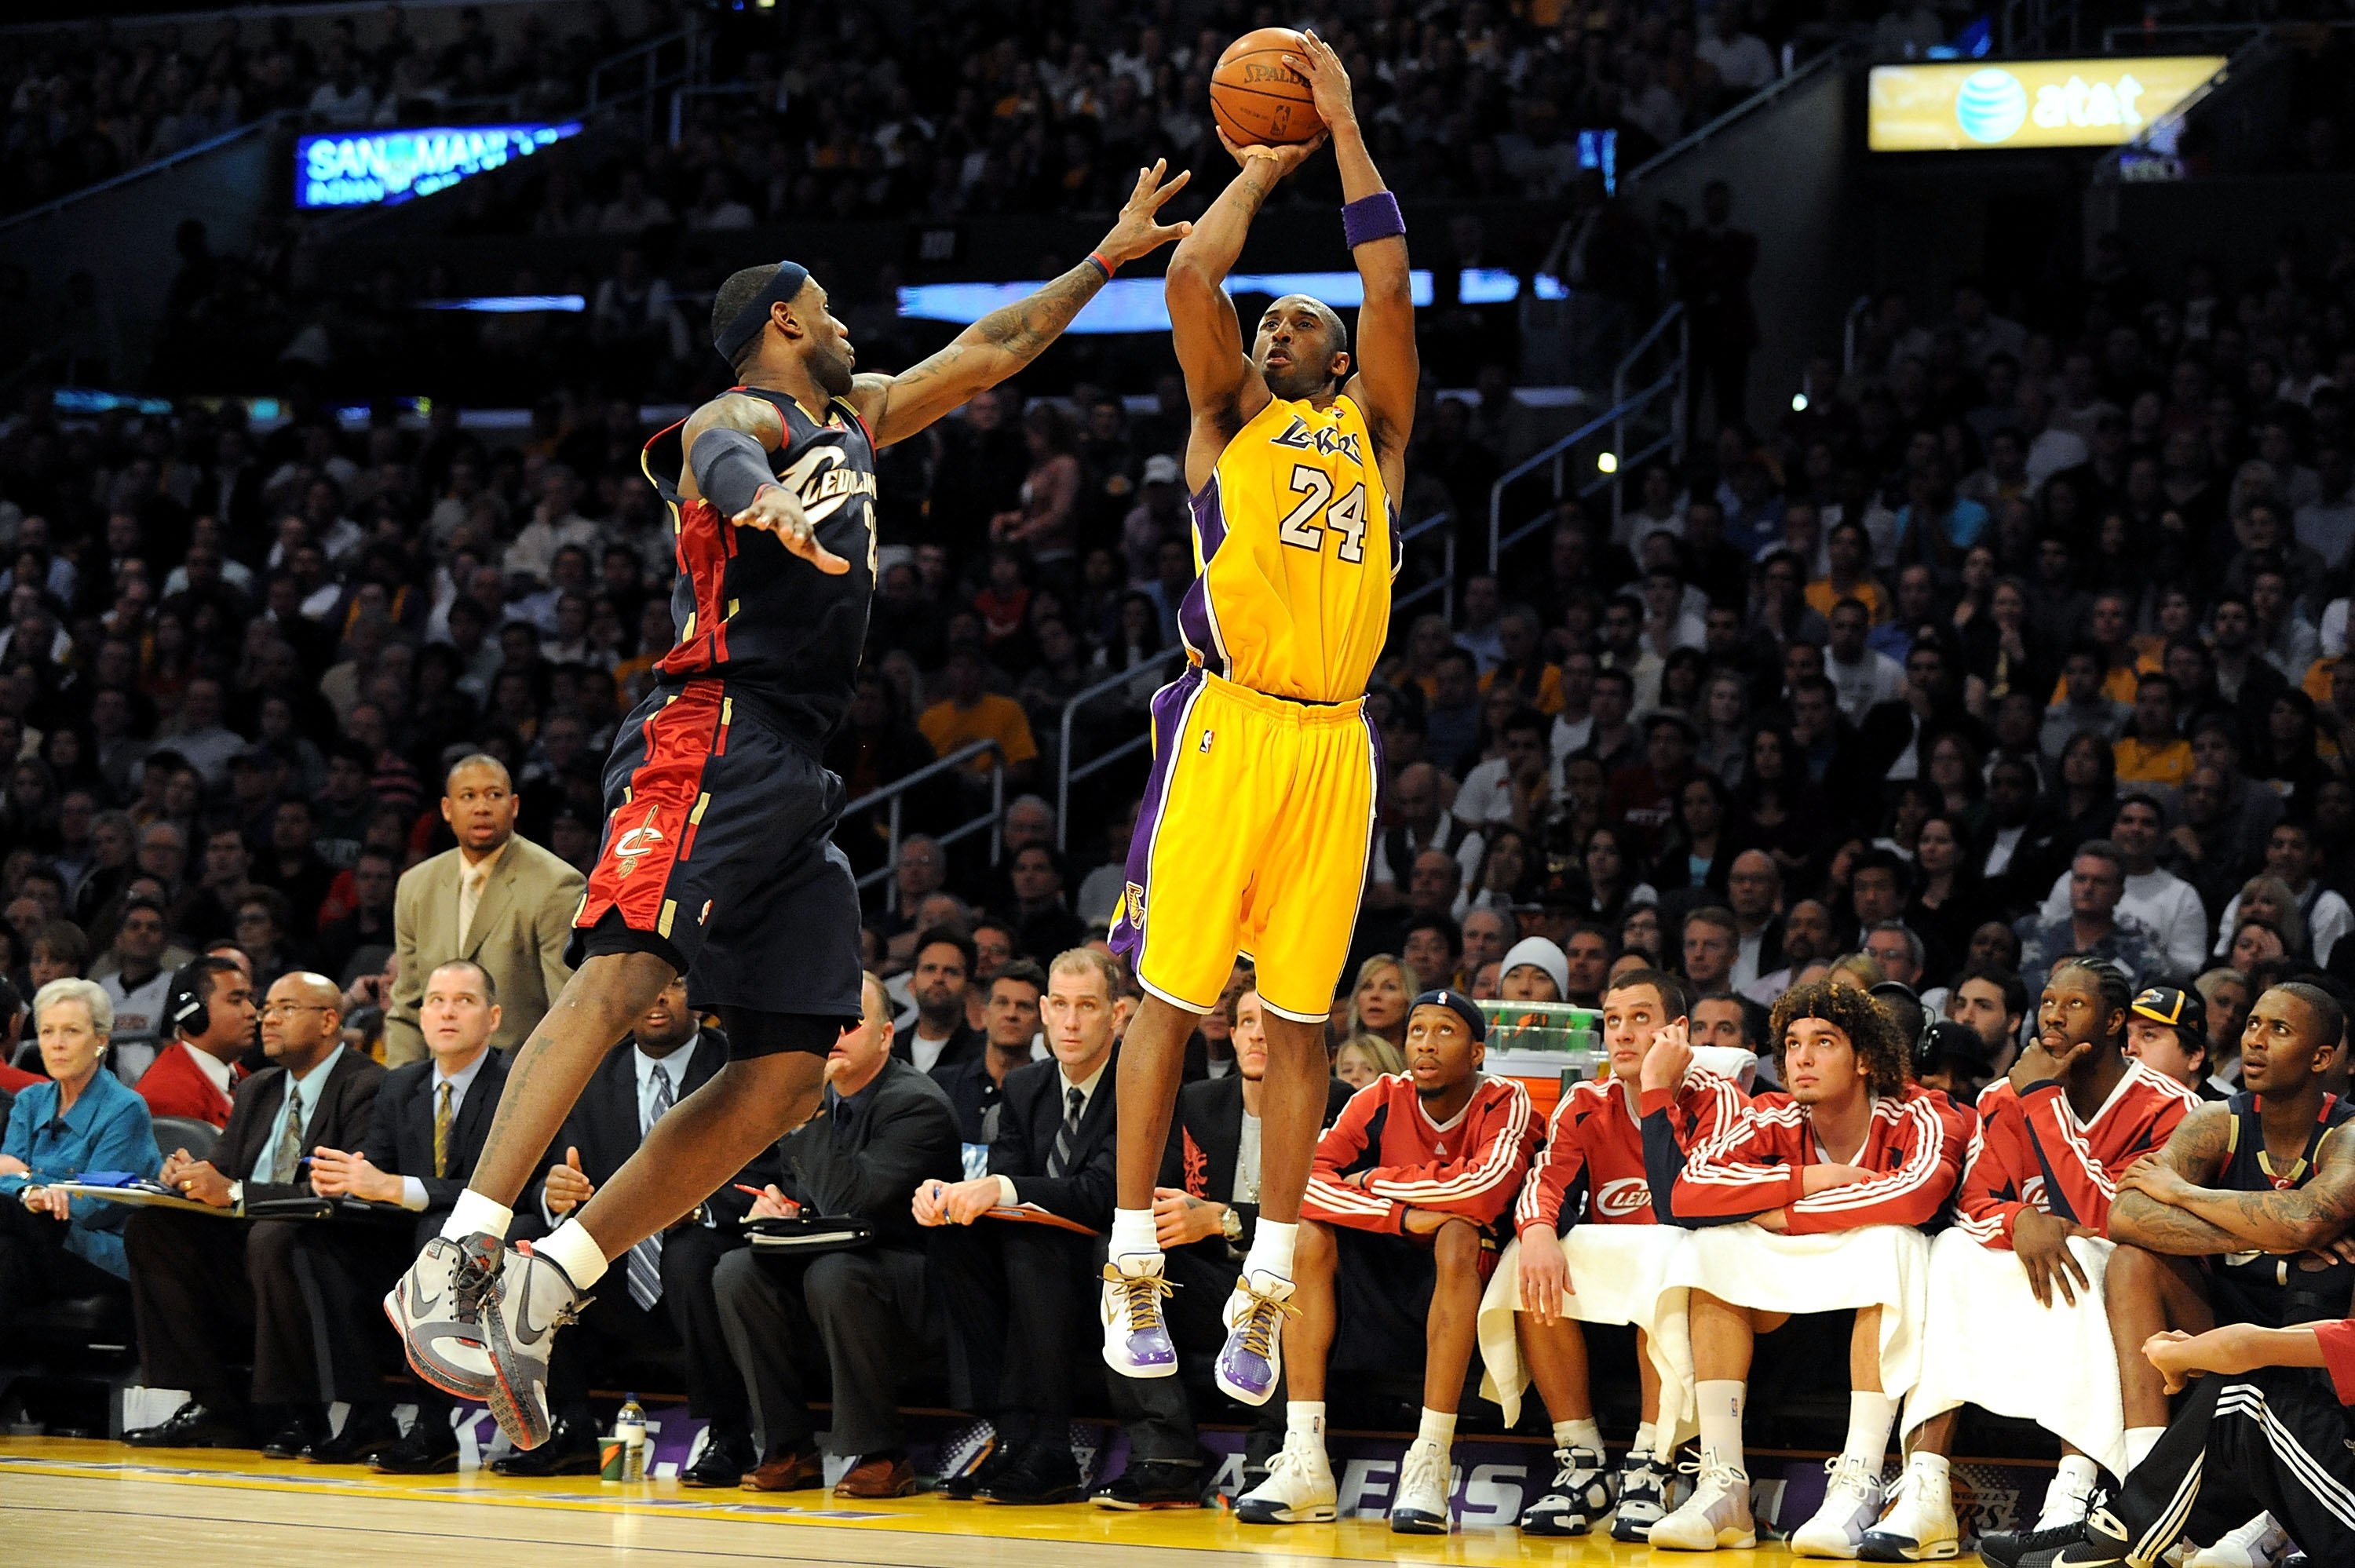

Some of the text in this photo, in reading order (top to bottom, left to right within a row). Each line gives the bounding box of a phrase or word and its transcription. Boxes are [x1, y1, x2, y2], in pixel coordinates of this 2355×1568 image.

[2032, 73, 2145, 128] at&t
[306, 138, 392, 181] SAN
[1279, 463, 1367, 564] 24
